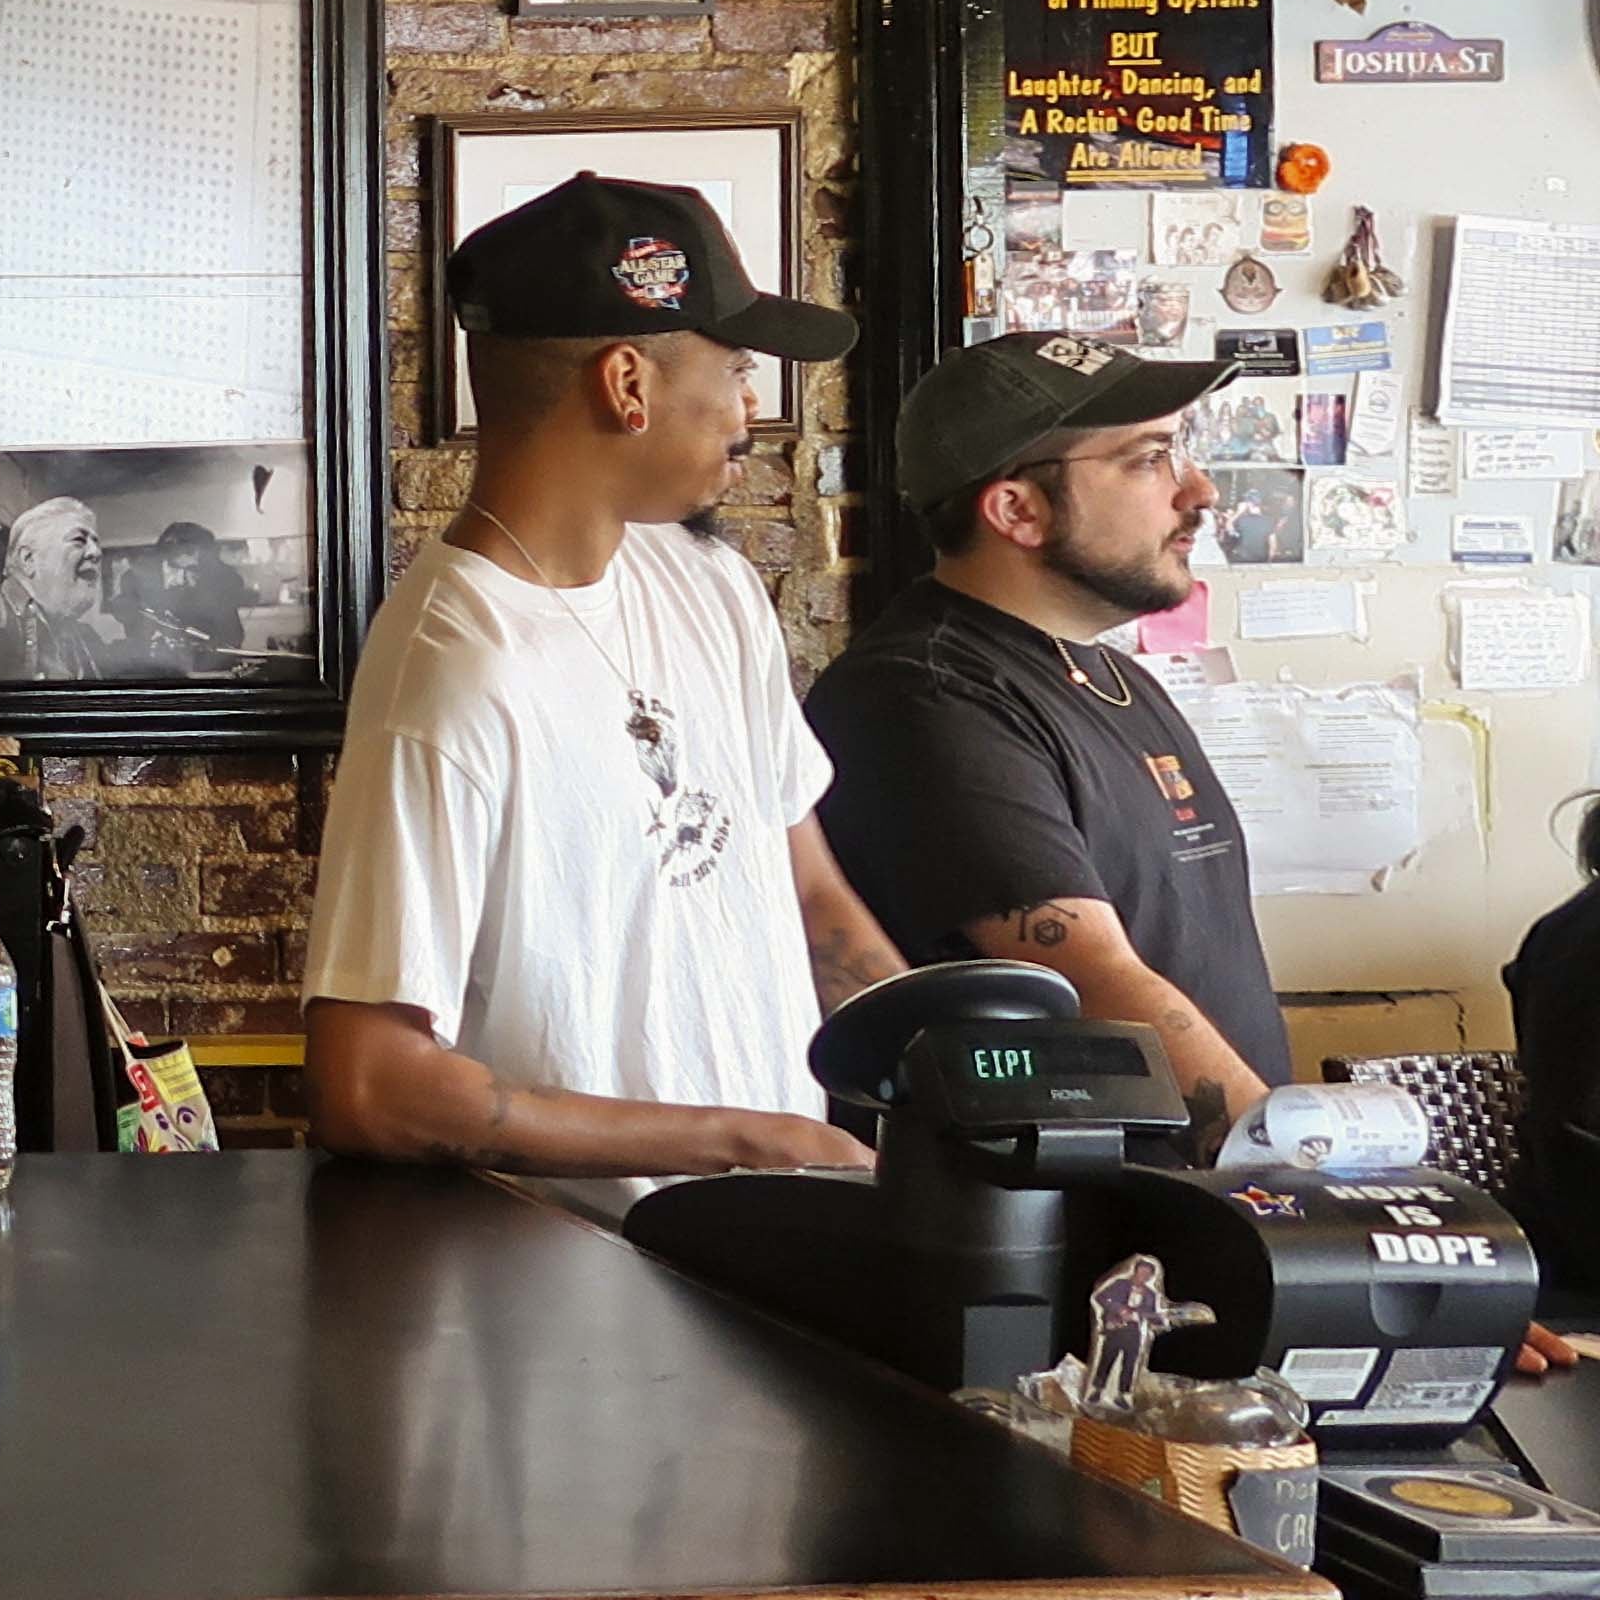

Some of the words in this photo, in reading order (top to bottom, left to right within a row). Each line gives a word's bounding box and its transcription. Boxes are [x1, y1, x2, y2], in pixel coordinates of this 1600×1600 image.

[1111, 32, 1159, 59] BUT
[1009, 70, 1112, 103] Laughter,
[1121, 69, 1214, 101] Dancing,
[1224, 70, 1262, 96] and
[1020, 109, 1038, 135] A
[1137, 107, 1192, 134] Good
[1201, 107, 1252, 133] Time
[1071, 144, 1109, 170] Are
[1118, 142, 1203, 169] Allowed
[1323, 1185, 1456, 1202] HOPE
[1383, 1204, 1443, 1228] IS
[1369, 1231, 1498, 1268] DOPE
